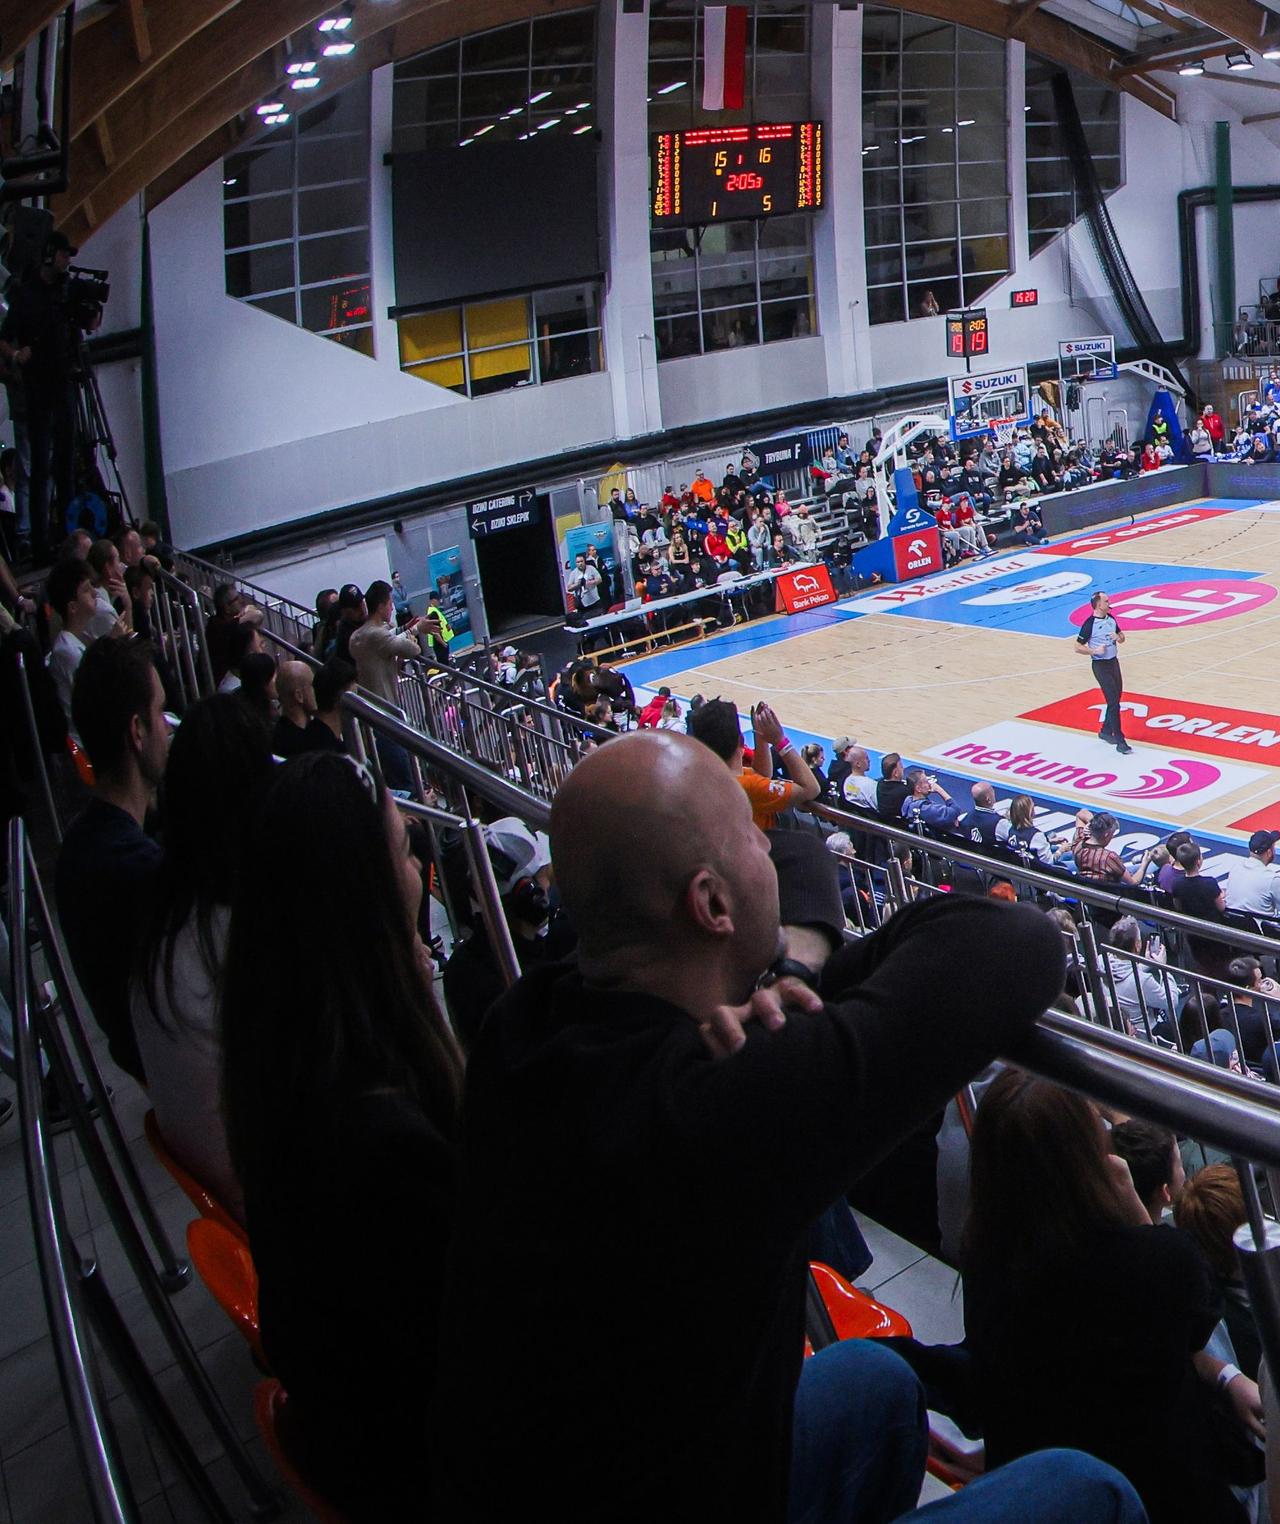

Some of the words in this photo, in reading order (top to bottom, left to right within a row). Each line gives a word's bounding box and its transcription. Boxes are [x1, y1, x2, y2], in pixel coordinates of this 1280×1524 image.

[714, 151, 727, 167] 15
[758, 147, 771, 163] 16
[763, 194, 772, 212] 5
[969, 319, 985, 332] 2:05
[971, 331, 985, 352] 19
[1075, 342, 1106, 352] SUZUKI
[974, 374, 1018, 390] SUZUKI
[907, 557, 932, 571] ORLEN
[793, 598, 810, 609] Bank
[941, 741, 1119, 790] netuno
